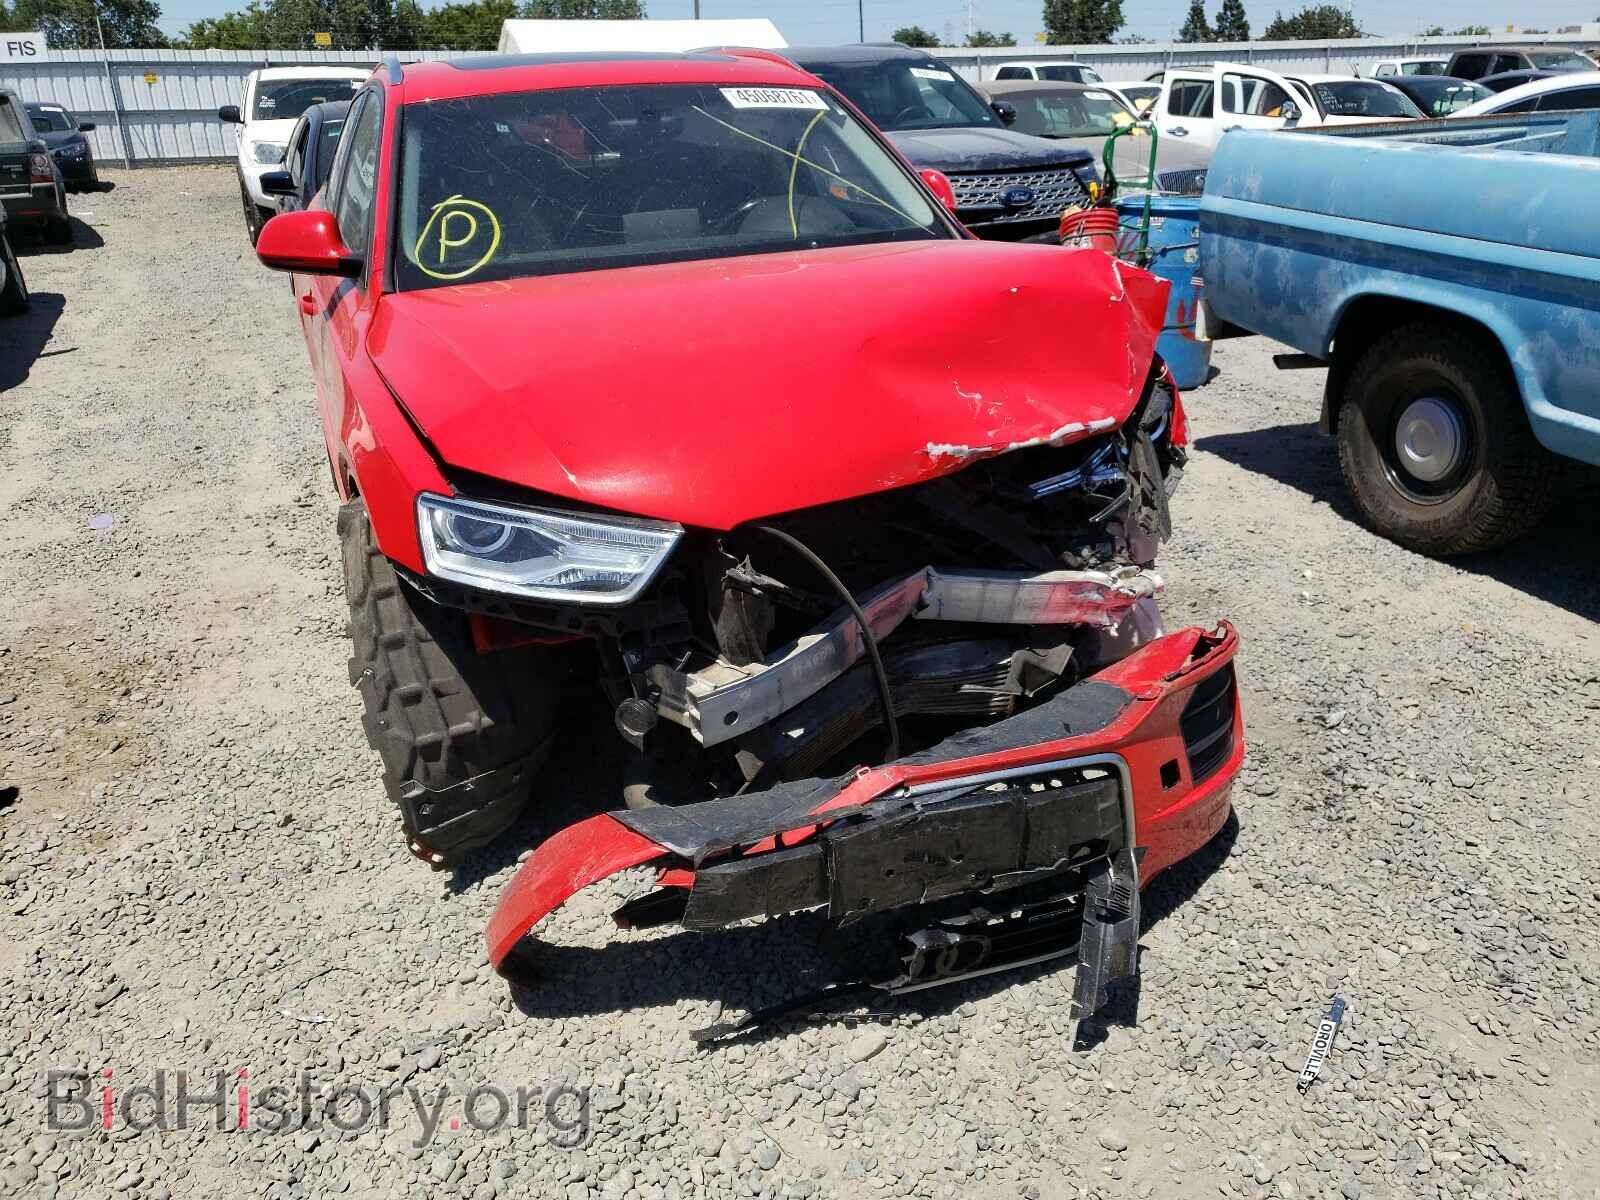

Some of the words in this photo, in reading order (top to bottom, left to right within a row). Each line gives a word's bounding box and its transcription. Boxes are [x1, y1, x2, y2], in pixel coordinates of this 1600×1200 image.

[7, 41, 36, 56] FIS
[735, 88, 812, 105] 45068761
[438, 210, 477, 264] P
[1303, 1023, 1333, 1078] OROVILLE
